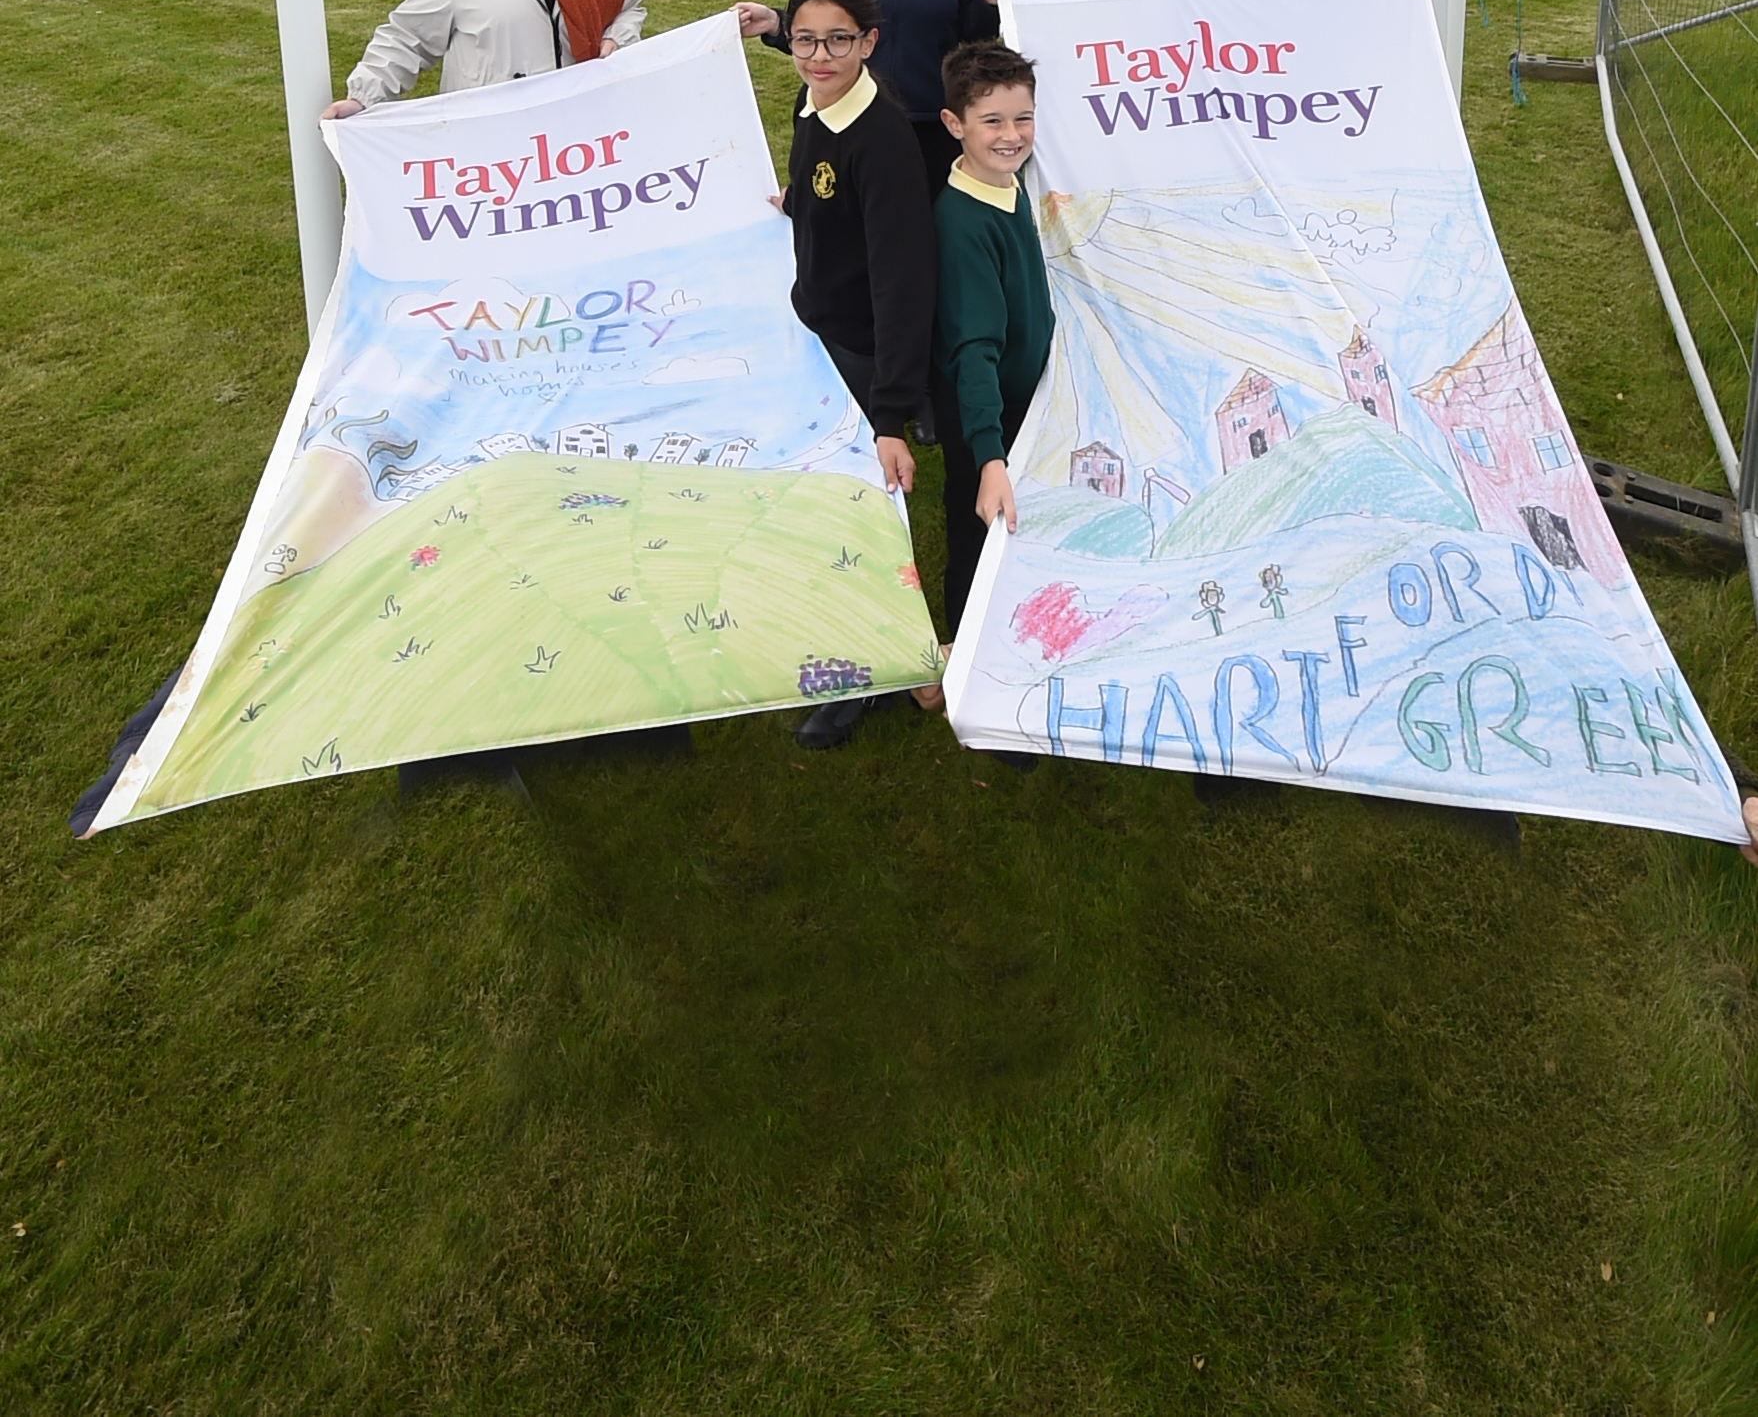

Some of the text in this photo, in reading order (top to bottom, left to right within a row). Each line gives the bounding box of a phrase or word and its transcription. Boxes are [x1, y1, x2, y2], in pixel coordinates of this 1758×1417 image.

[1075, 20, 1296, 95] Taylor
[1082, 85, 1382, 141] Wimpey
[403, 129, 630, 206] Taylor
[403, 157, 710, 242] Wimpey
[408, 279, 657, 331] TAYLOR
[441, 319, 676, 363] WIMPEY
